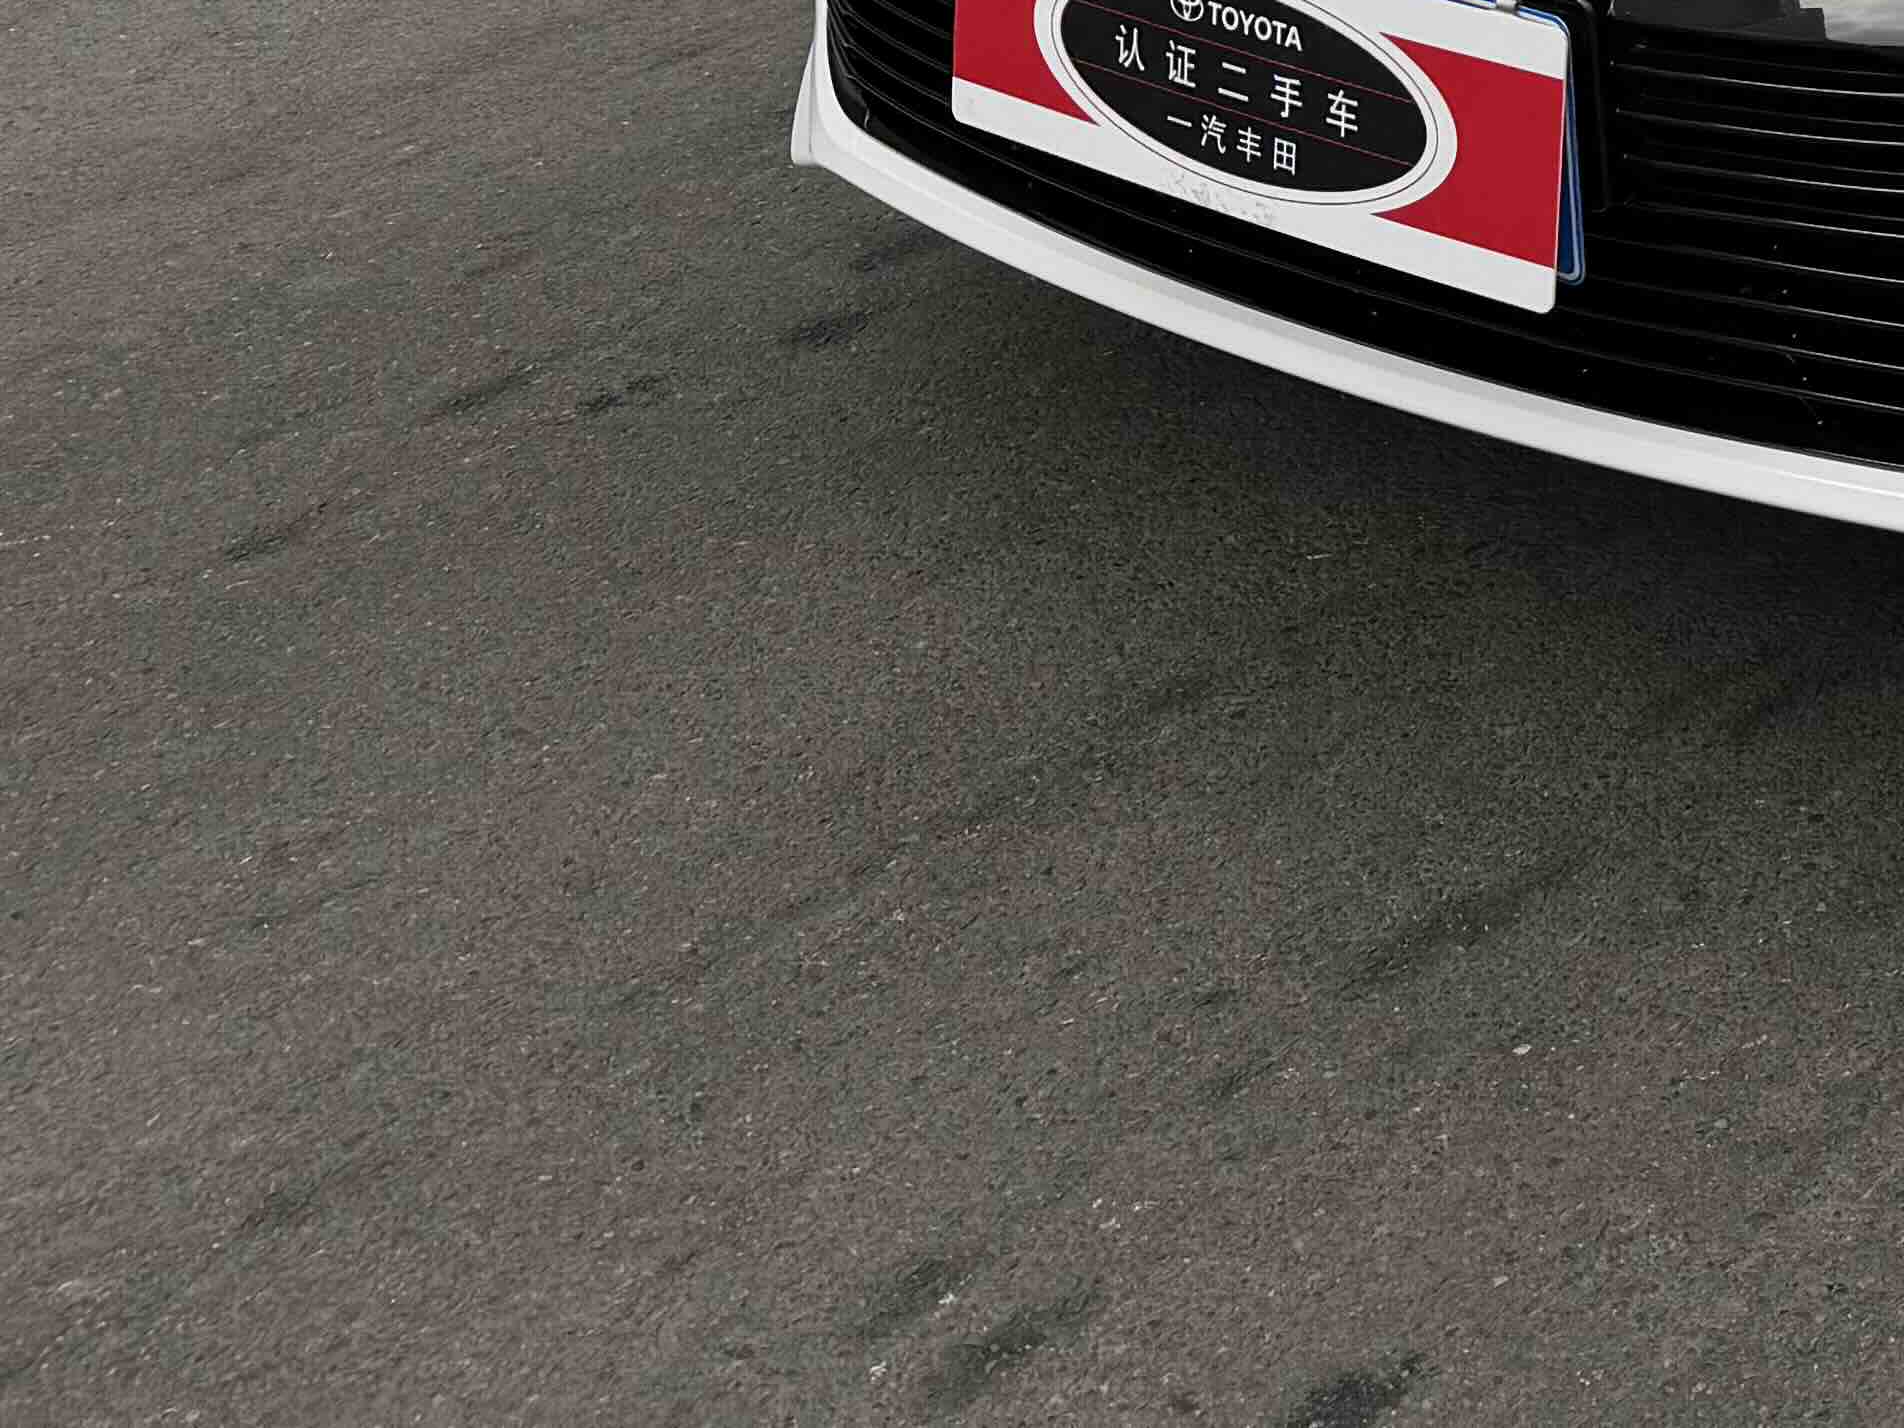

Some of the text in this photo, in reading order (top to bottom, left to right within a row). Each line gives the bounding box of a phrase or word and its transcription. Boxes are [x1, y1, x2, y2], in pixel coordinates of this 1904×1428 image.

[1207, 0, 1303, 51] TOYOTA
[1115, 24, 1359, 138] 认证二手车
[1166, 114, 1297, 176] 一汽丰田
